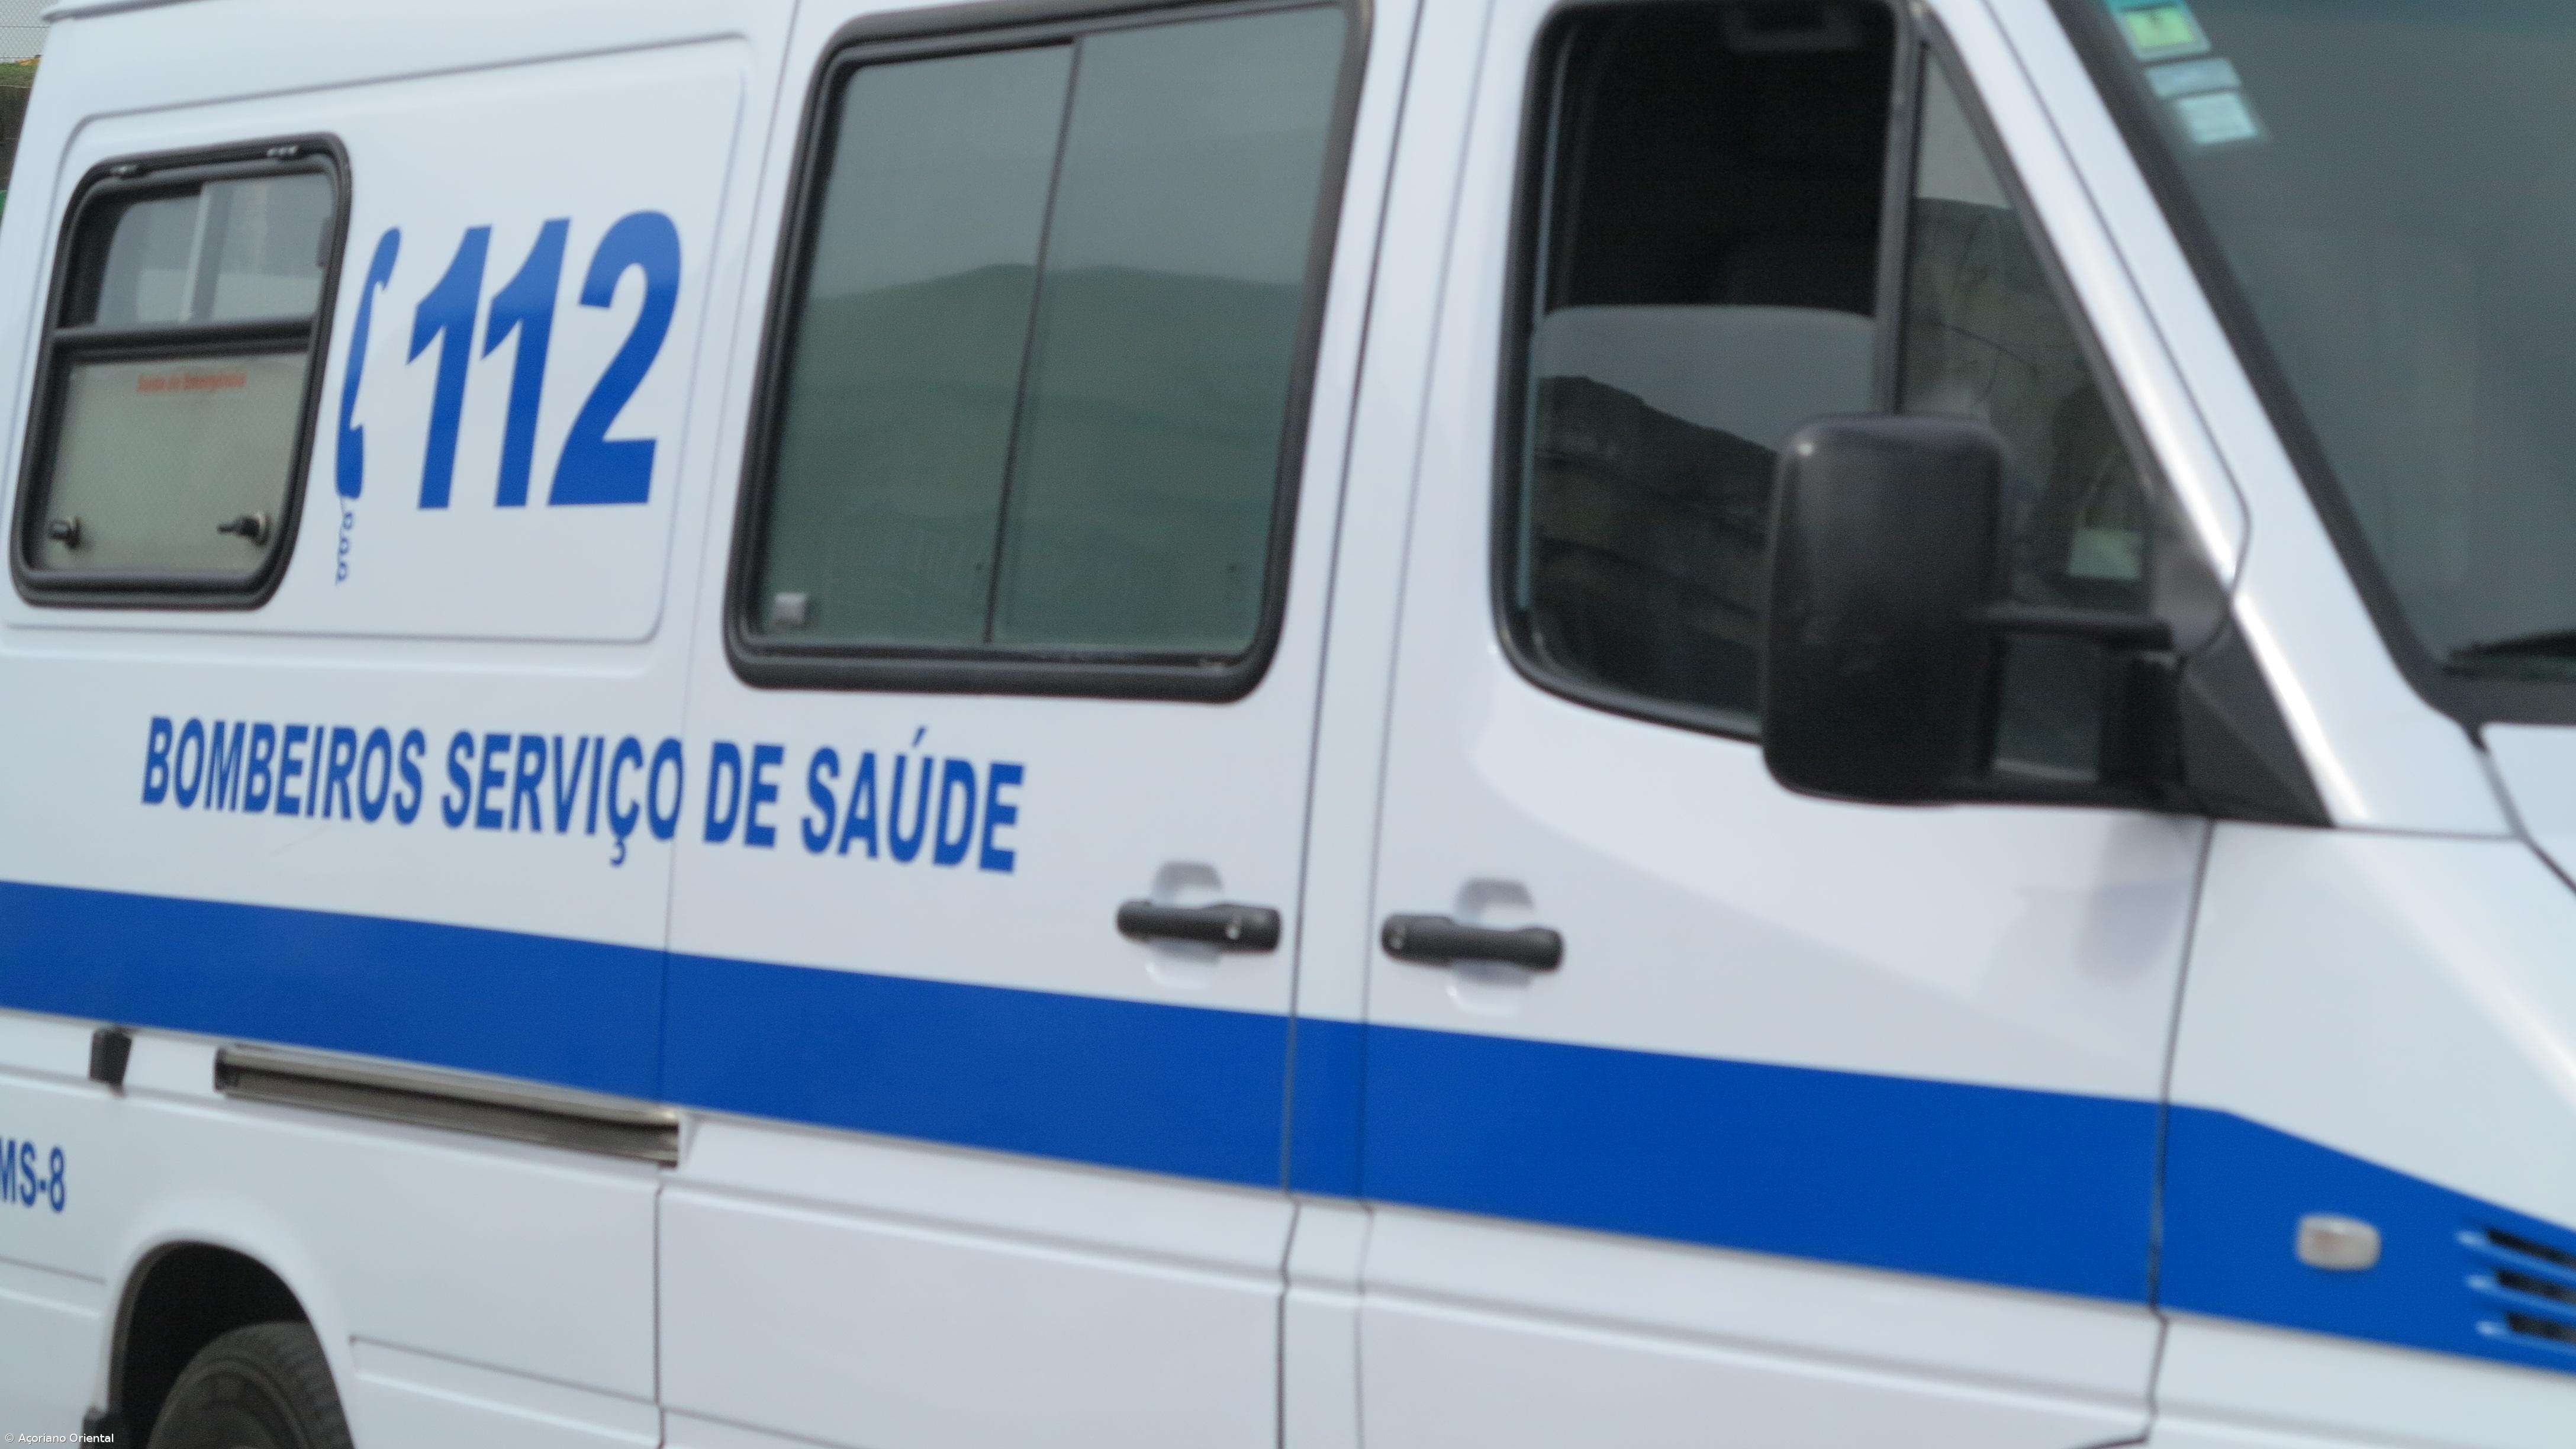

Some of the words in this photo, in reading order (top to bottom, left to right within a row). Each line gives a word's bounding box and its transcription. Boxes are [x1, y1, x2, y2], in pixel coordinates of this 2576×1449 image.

[407, 209, 681, 510] 112
[141, 715, 426, 826] BOMBEIROS
[440, 729, 684, 867] SERVIÇO
[703, 739, 785, 849] DE
[800, 726, 1025, 873] SAÚDE
